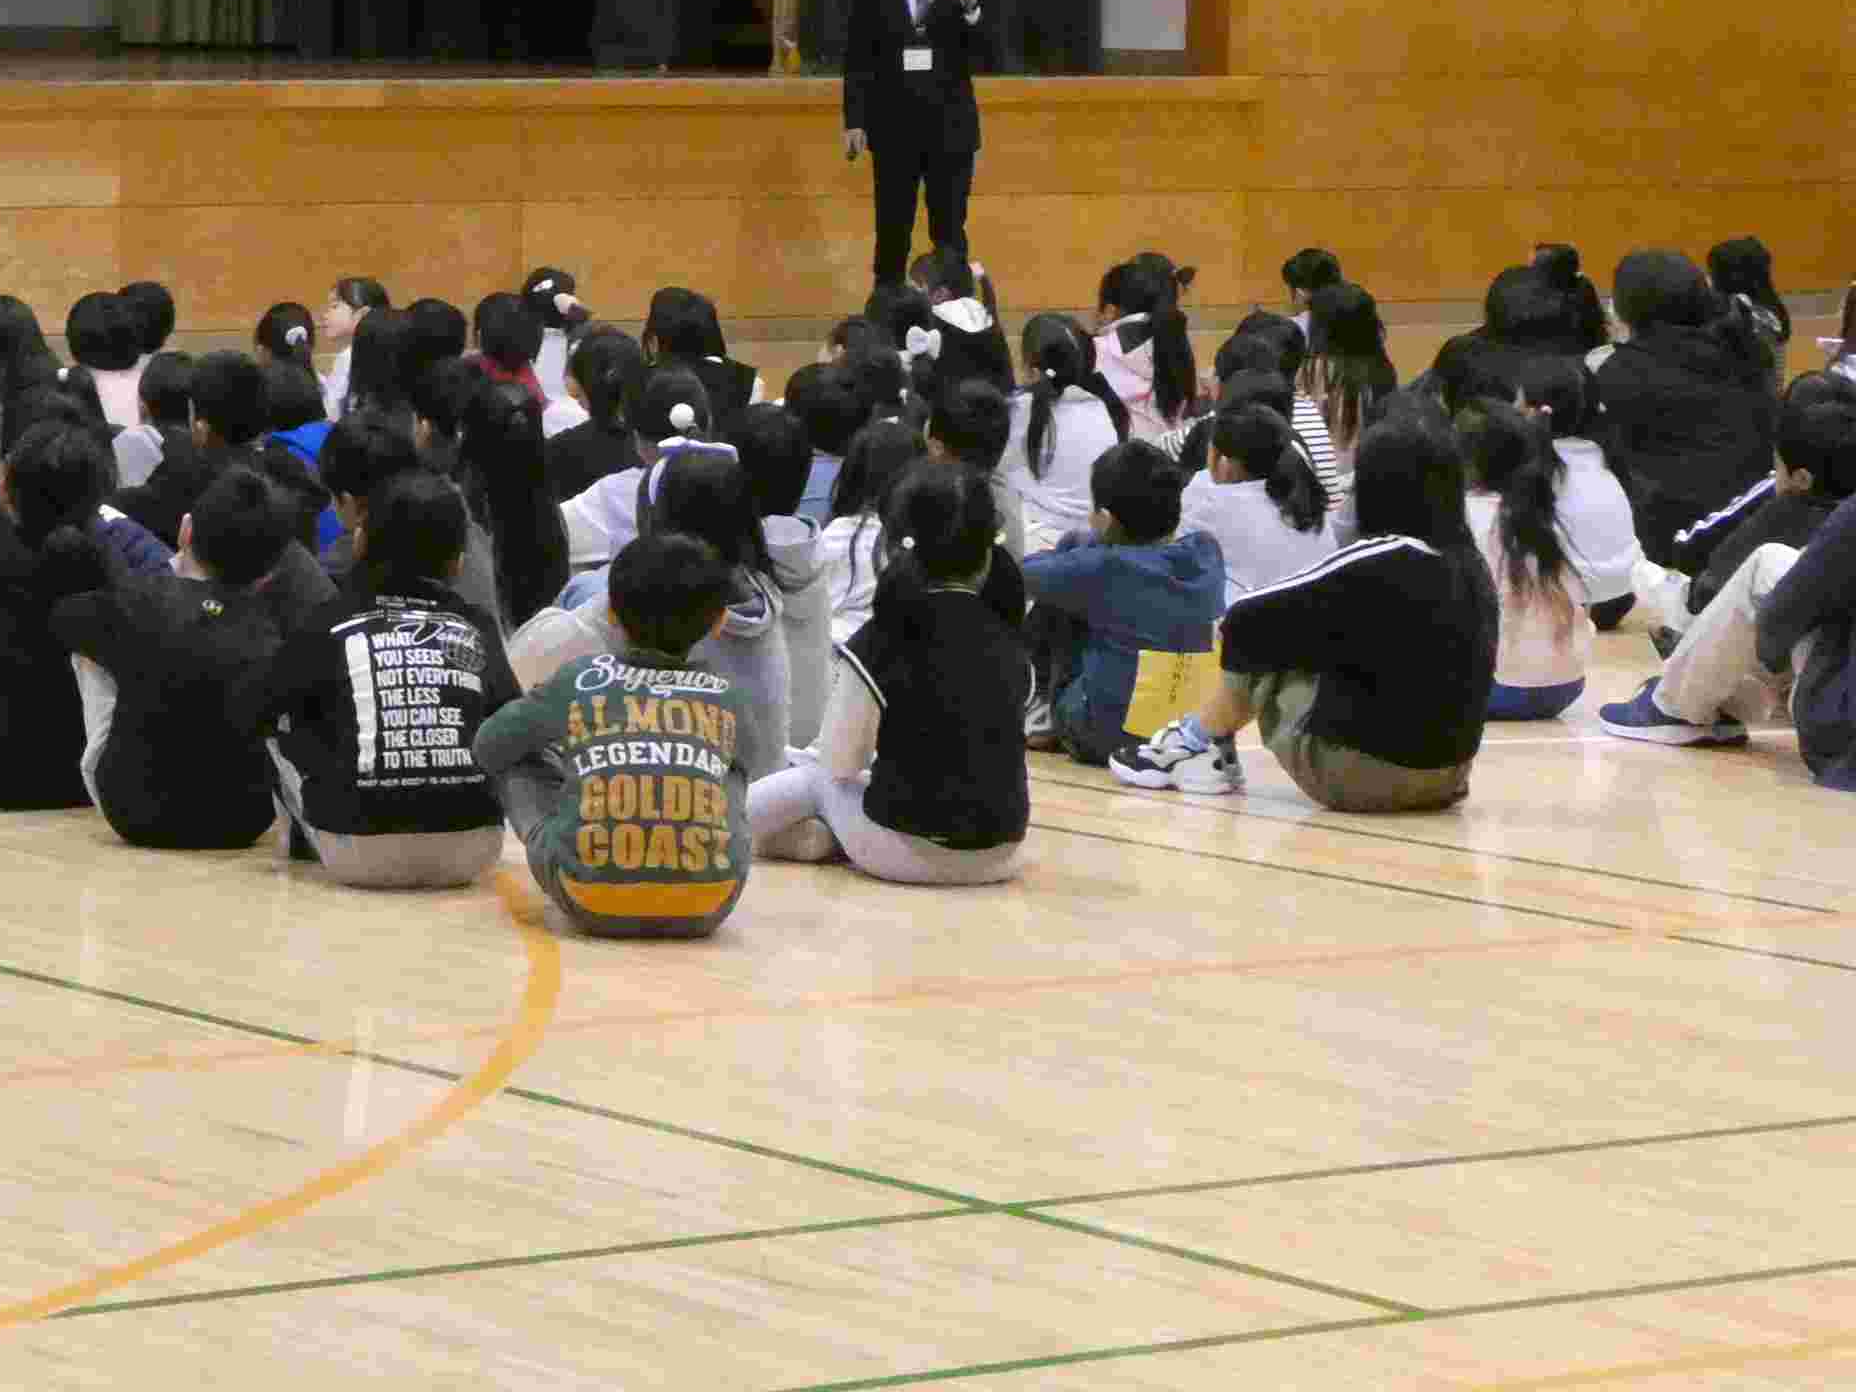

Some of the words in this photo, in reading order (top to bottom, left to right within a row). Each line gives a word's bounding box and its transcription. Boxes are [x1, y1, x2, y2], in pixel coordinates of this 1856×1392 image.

[371, 631, 412, 649] WHAT
[374, 649, 403, 667] YOU
[376, 670, 405, 687] NOT
[575, 654, 729, 697] Superior
[378, 689, 405, 707] THE
[407, 687, 441, 705] LESS
[381, 708, 408, 727] YOU
[409, 707, 438, 725] CAN
[439, 707, 465, 726] SEE
[382, 729, 409, 748] THE
[409, 727, 460, 747] CLOSER
[382, 751, 401, 769] TO
[401, 749, 428, 768] THE
[429, 748, 474, 768] TRUTH
